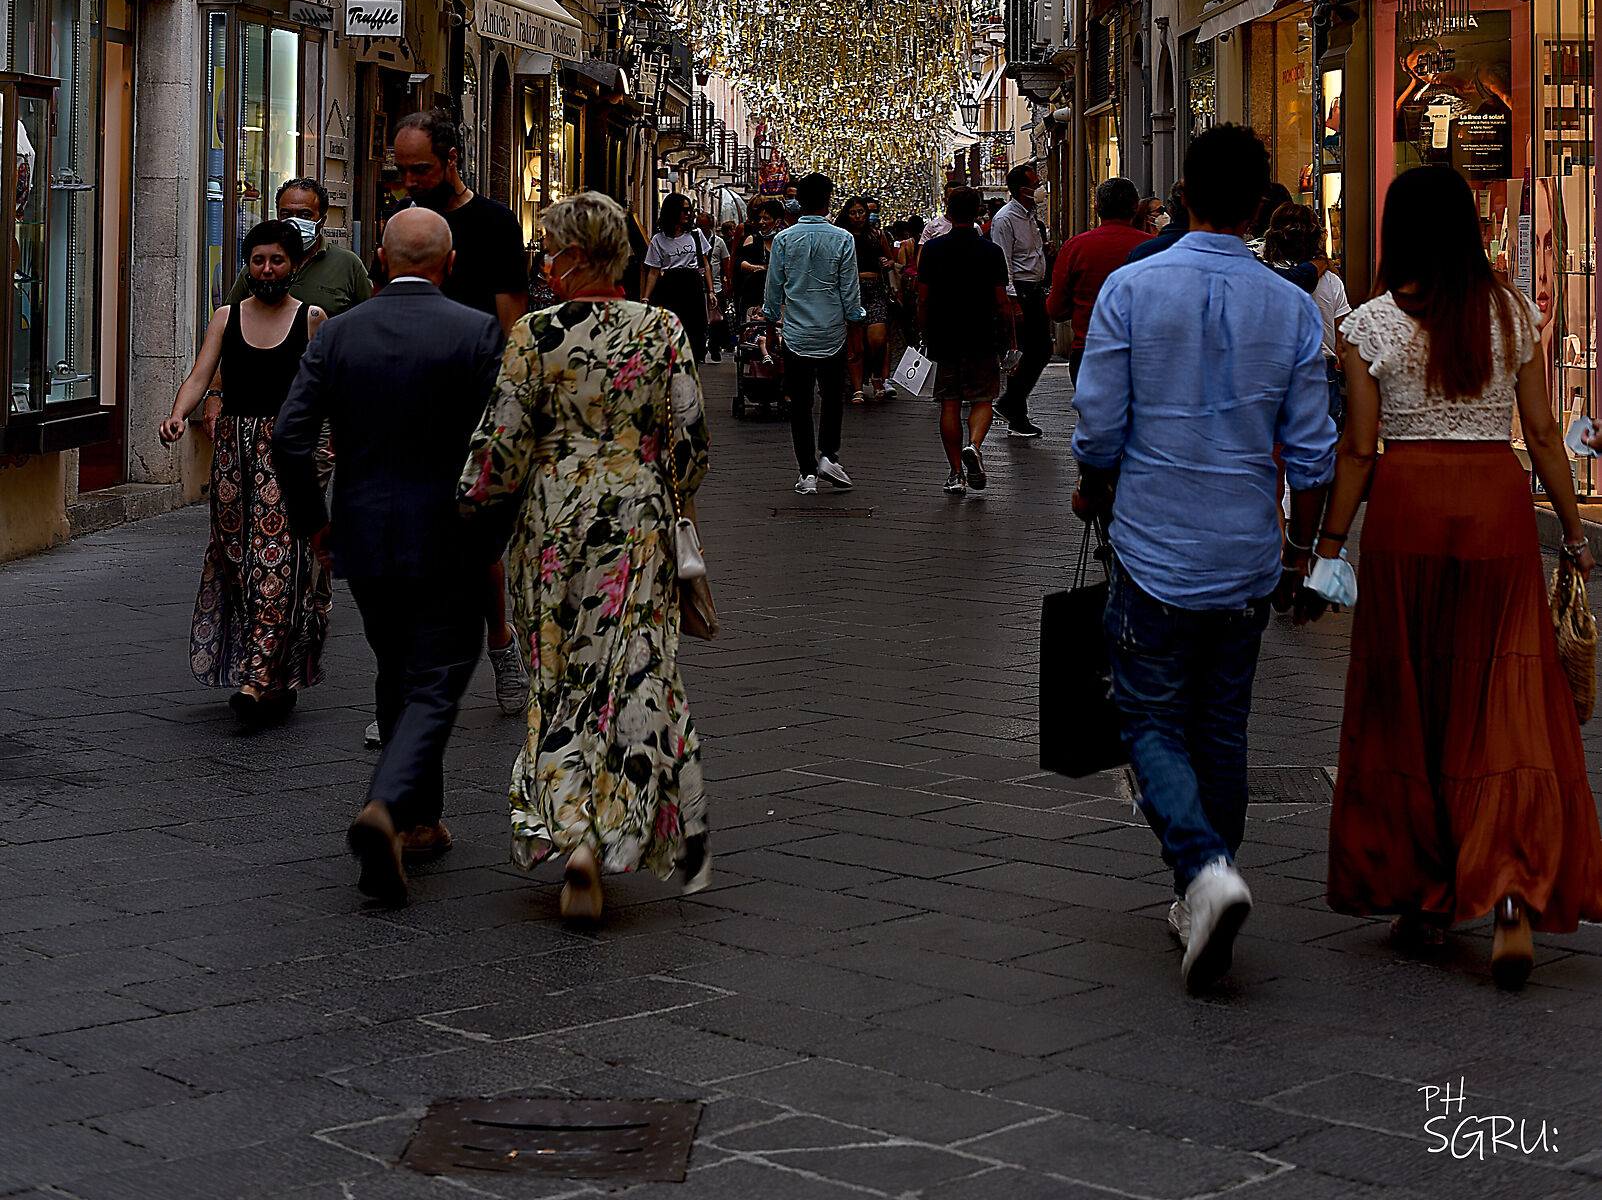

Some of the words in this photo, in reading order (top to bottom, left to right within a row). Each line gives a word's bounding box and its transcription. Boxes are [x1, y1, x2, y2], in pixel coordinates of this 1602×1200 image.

[349, 7, 398, 30] Truffle
[481, 2, 511, 39] Antiche
[514, 11, 546, 48] Tradizioni
[550, 23, 577, 57] Siciliane
